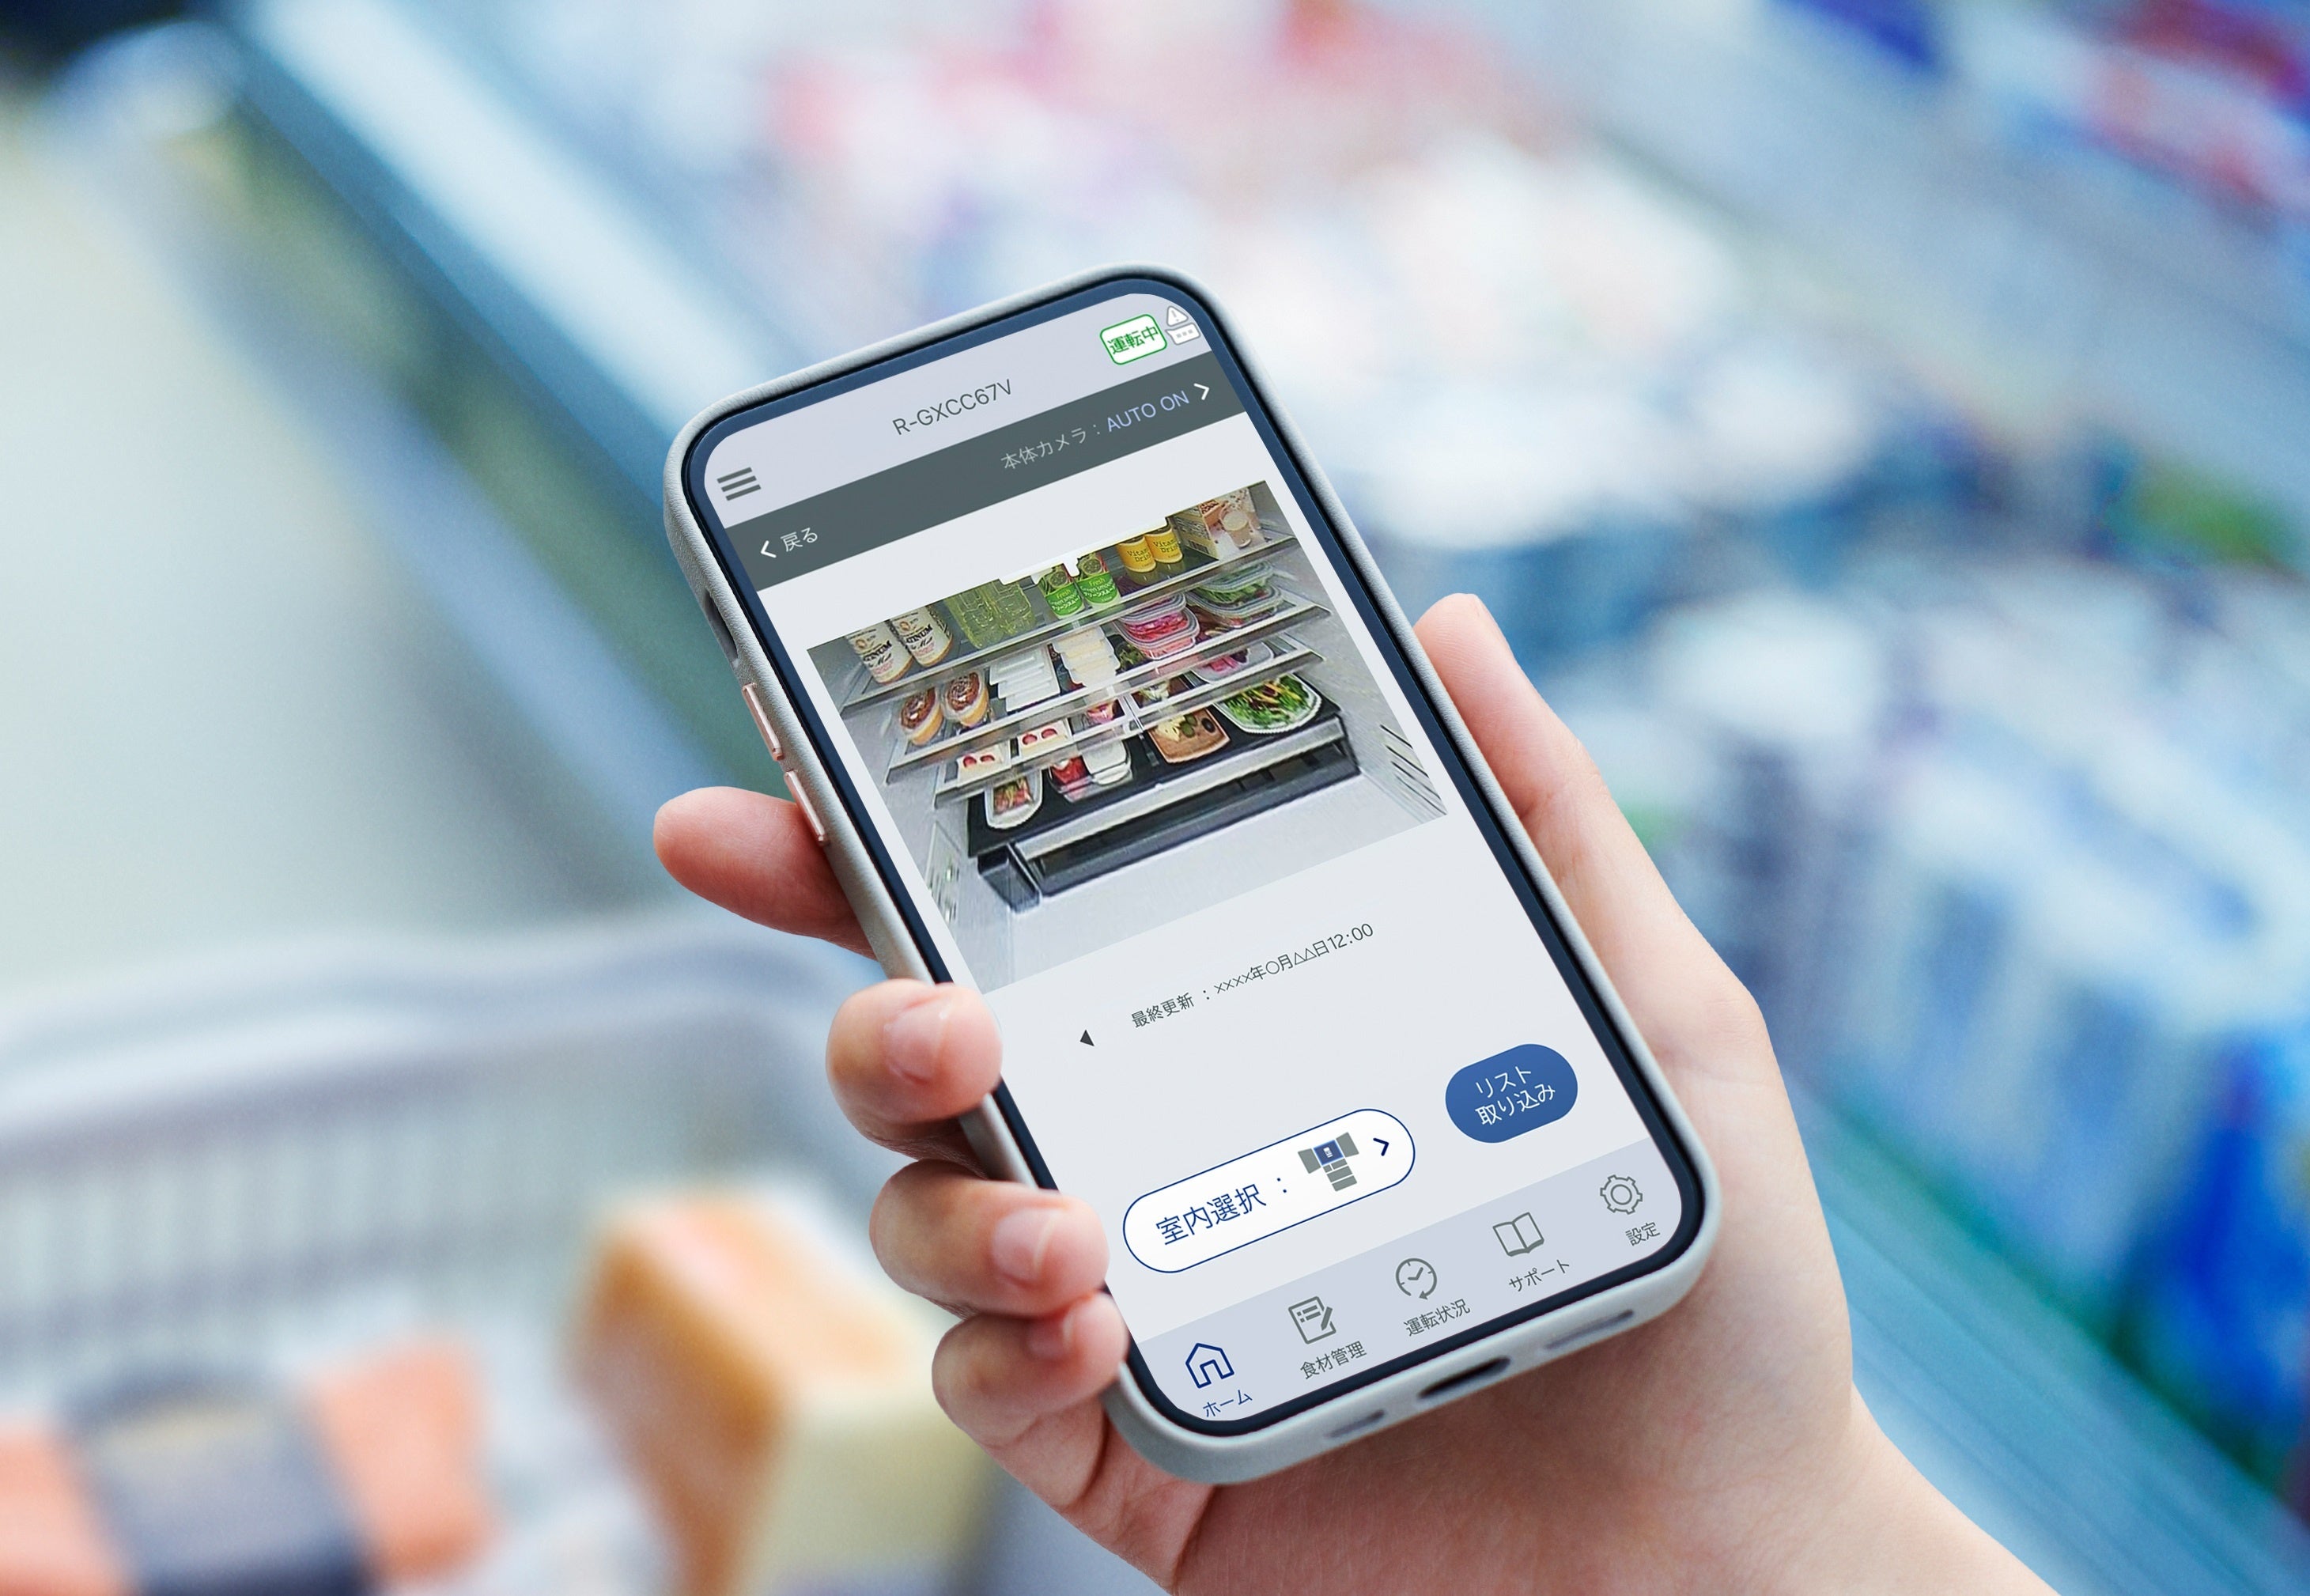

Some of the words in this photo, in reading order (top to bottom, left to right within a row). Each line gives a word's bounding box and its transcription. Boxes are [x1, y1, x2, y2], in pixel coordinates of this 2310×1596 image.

[1108, 326, 1159, 355] 運転中
[893, 379, 1011, 435] R-GXCC67V
[1107, 403, 1156, 432] AUTO
[1160, 391, 1190, 413] ON
[781, 528, 818, 552] 戻る
[1476, 1066, 1532, 1098] リスト
[1475, 1084, 1556, 1125] 取り込み
[1626, 1222, 1660, 1246] 設定
[1509, 1258, 1570, 1292] サポート
[1404, 1299, 1471, 1337] 運転状況
[1300, 1341, 1367, 1379] 食材管理
[1203, 1390, 1253, 1418] ホーム
